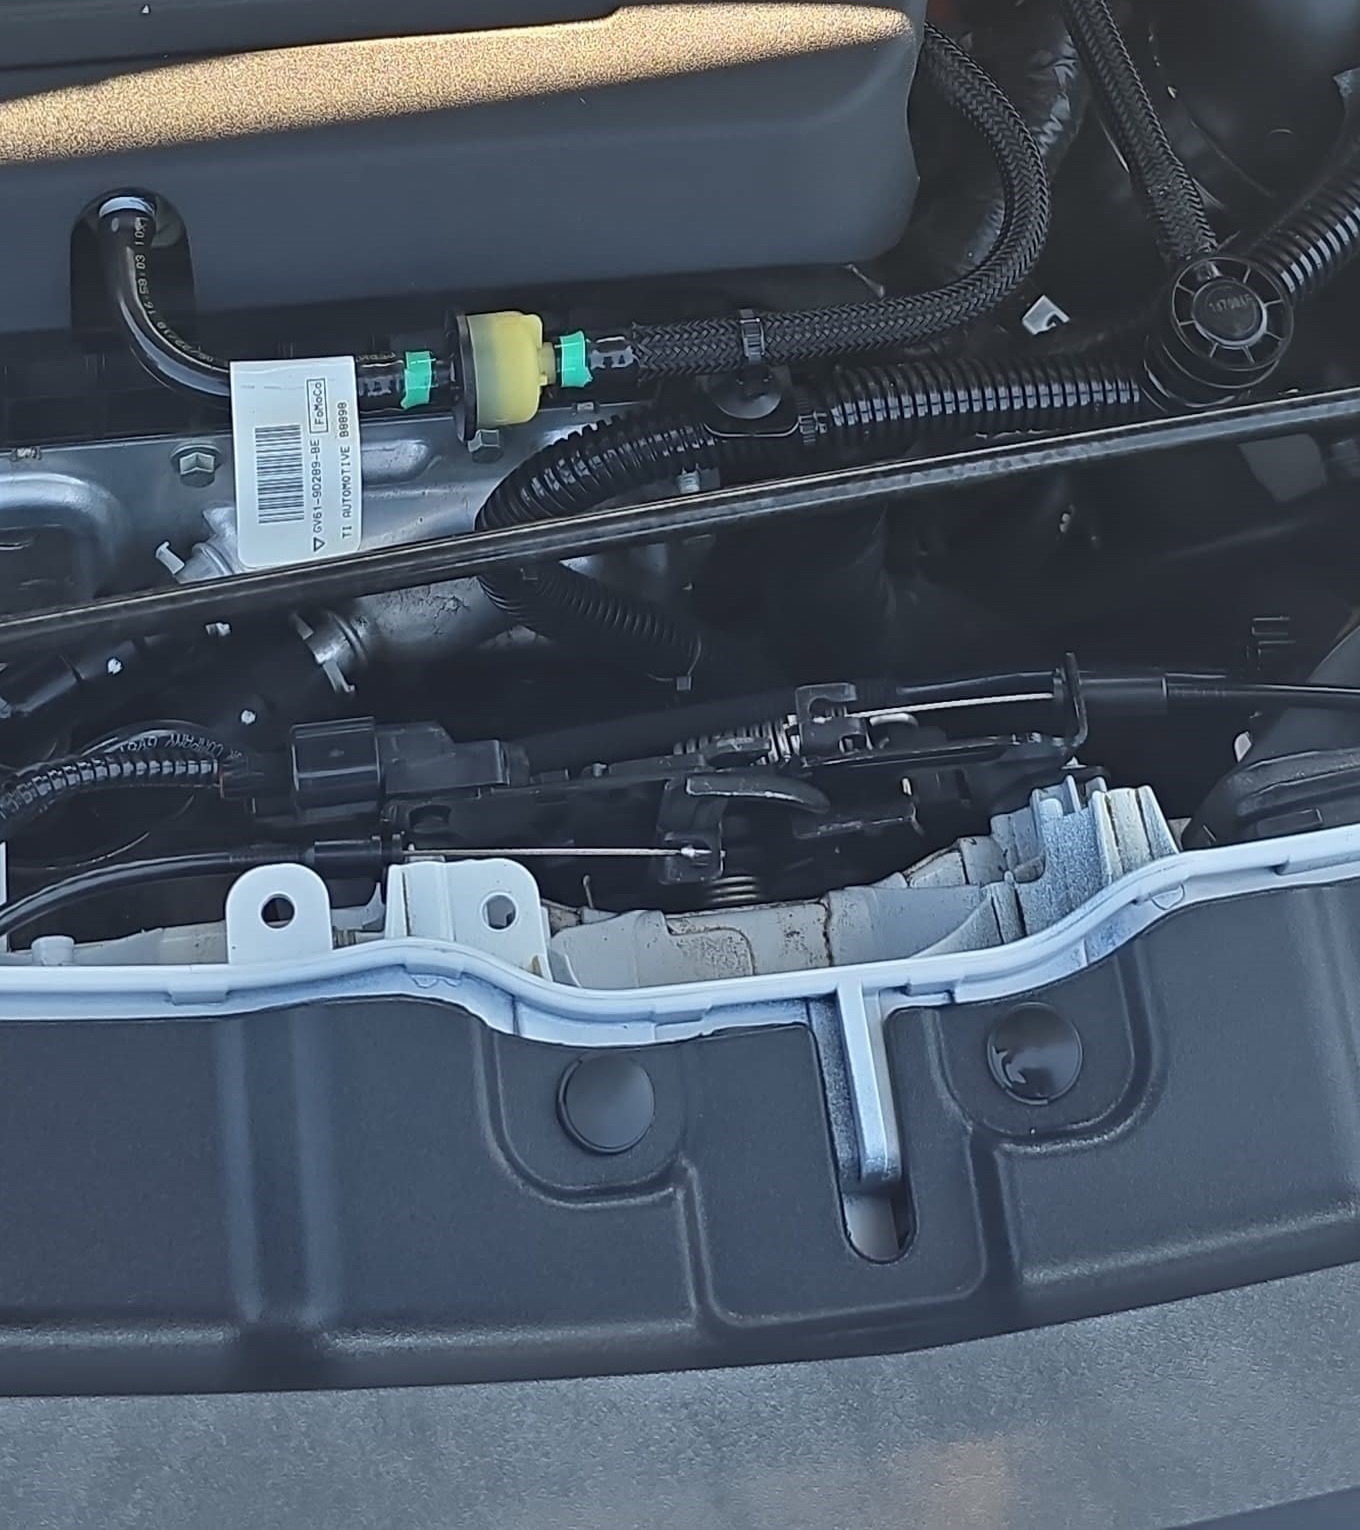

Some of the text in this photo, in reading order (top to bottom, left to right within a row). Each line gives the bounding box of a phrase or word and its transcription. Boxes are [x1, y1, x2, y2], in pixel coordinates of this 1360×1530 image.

[309, 382, 324, 533] GV61-9D289-BE FoMoCo
[337, 401, 353, 538] TI AUTOMOTIVE B8898
